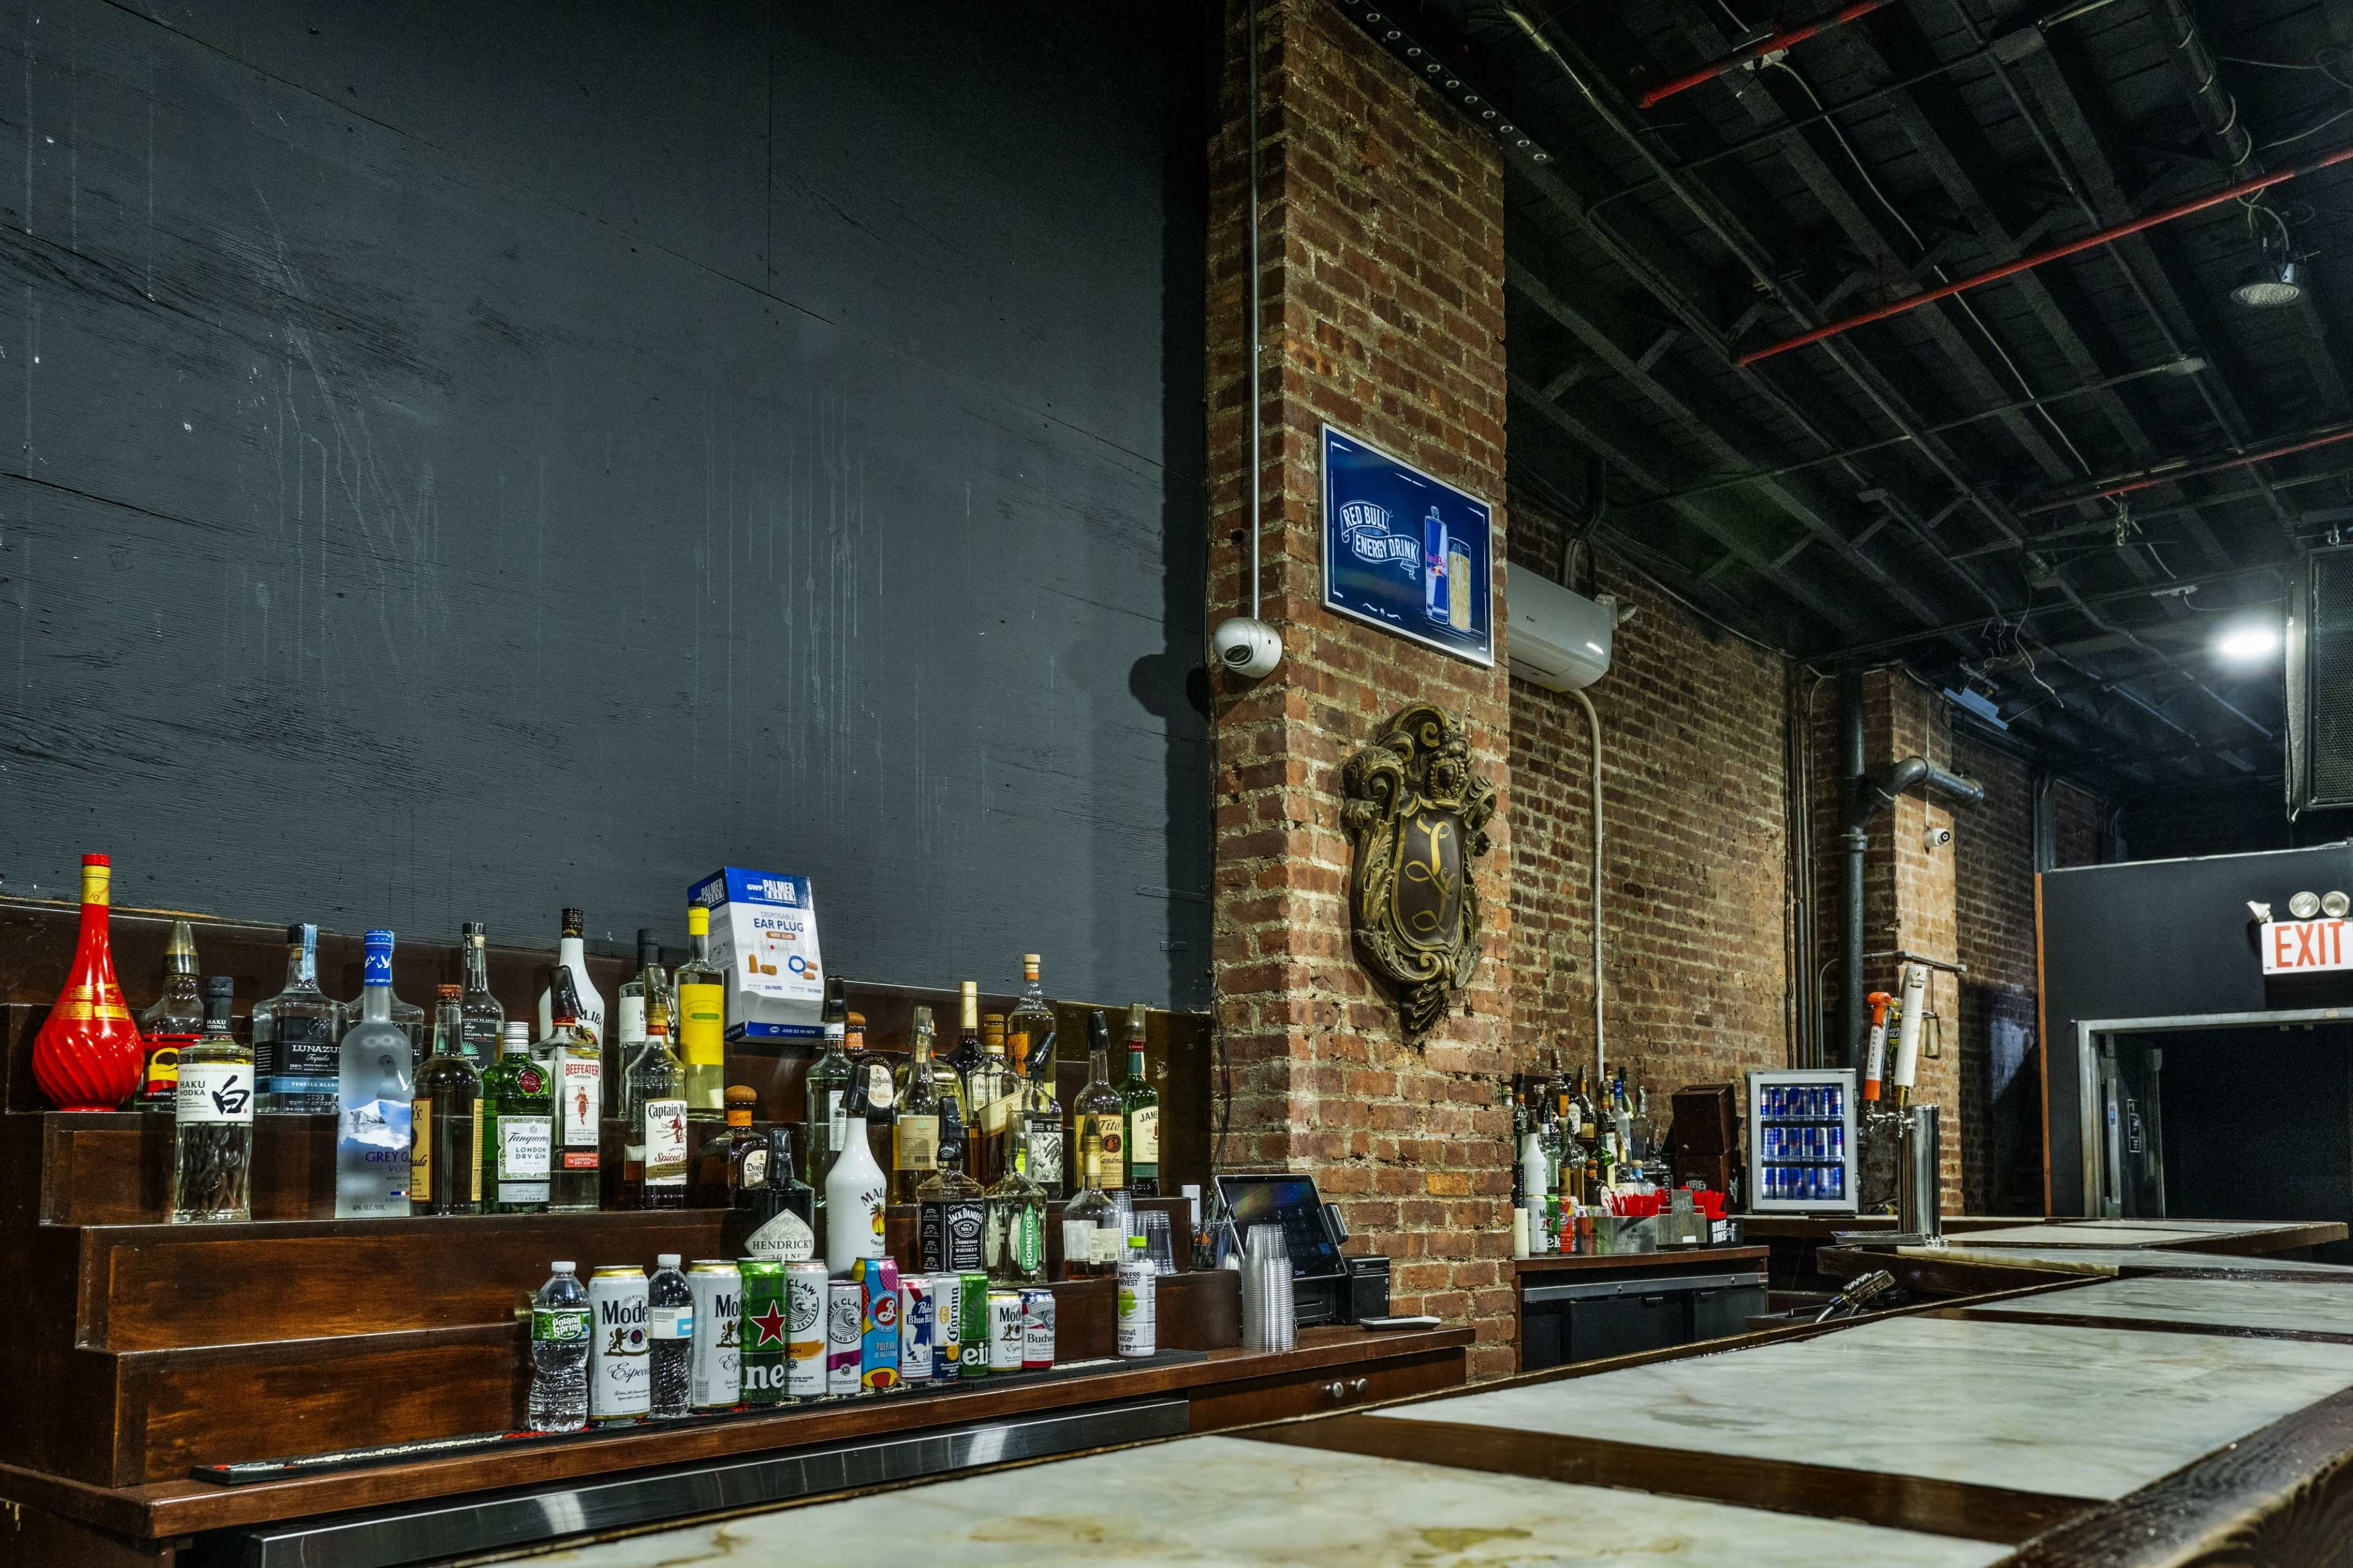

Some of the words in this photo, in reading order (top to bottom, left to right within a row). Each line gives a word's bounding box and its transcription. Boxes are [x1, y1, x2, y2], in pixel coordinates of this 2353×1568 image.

[1343, 506, 1362, 528] RED
[1363, 506, 1387, 529] BULL
[1355, 533, 1387, 559] ENERGY
[1388, 537, 1417, 562] DRINK
[746, 883, 763, 892] GWP
[762, 879, 795, 895] PALMER
[765, 891, 796, 902] SAFETY
[761, 911, 795, 920] DISPOSABLE
[754, 918, 775, 930] EAR
[777, 920, 804, 933] PLUG
[2275, 921, 2344, 968] EXIT
[306, 1053, 330, 1064] Tequila
[566, 1063, 599, 1077] BEEFEATER
[180, 1080, 205, 1089] HAKU
[648, 1104, 678, 1119] Captain
[507, 1132, 550, 1145] Tanqueray
[365, 1151, 398, 1162] GREY
[654, 1152, 681, 1163] Spiced
[948, 1210, 963, 1225] JACK
[787, 1279, 817, 1297] CLAW
[602, 1300, 648, 1325] Mode
[797, 1303, 817, 1330] SELTZER
[908, 1315, 925, 1324] Blue
[947, 1287, 960, 1342] Corona
[999, 1307, 1020, 1322] Mod
[553, 1314, 581, 1328] Poland
[553, 1324, 582, 1337] Spring
[831, 1331, 847, 1342] HARD
[607, 1362, 650, 1383] Especi
